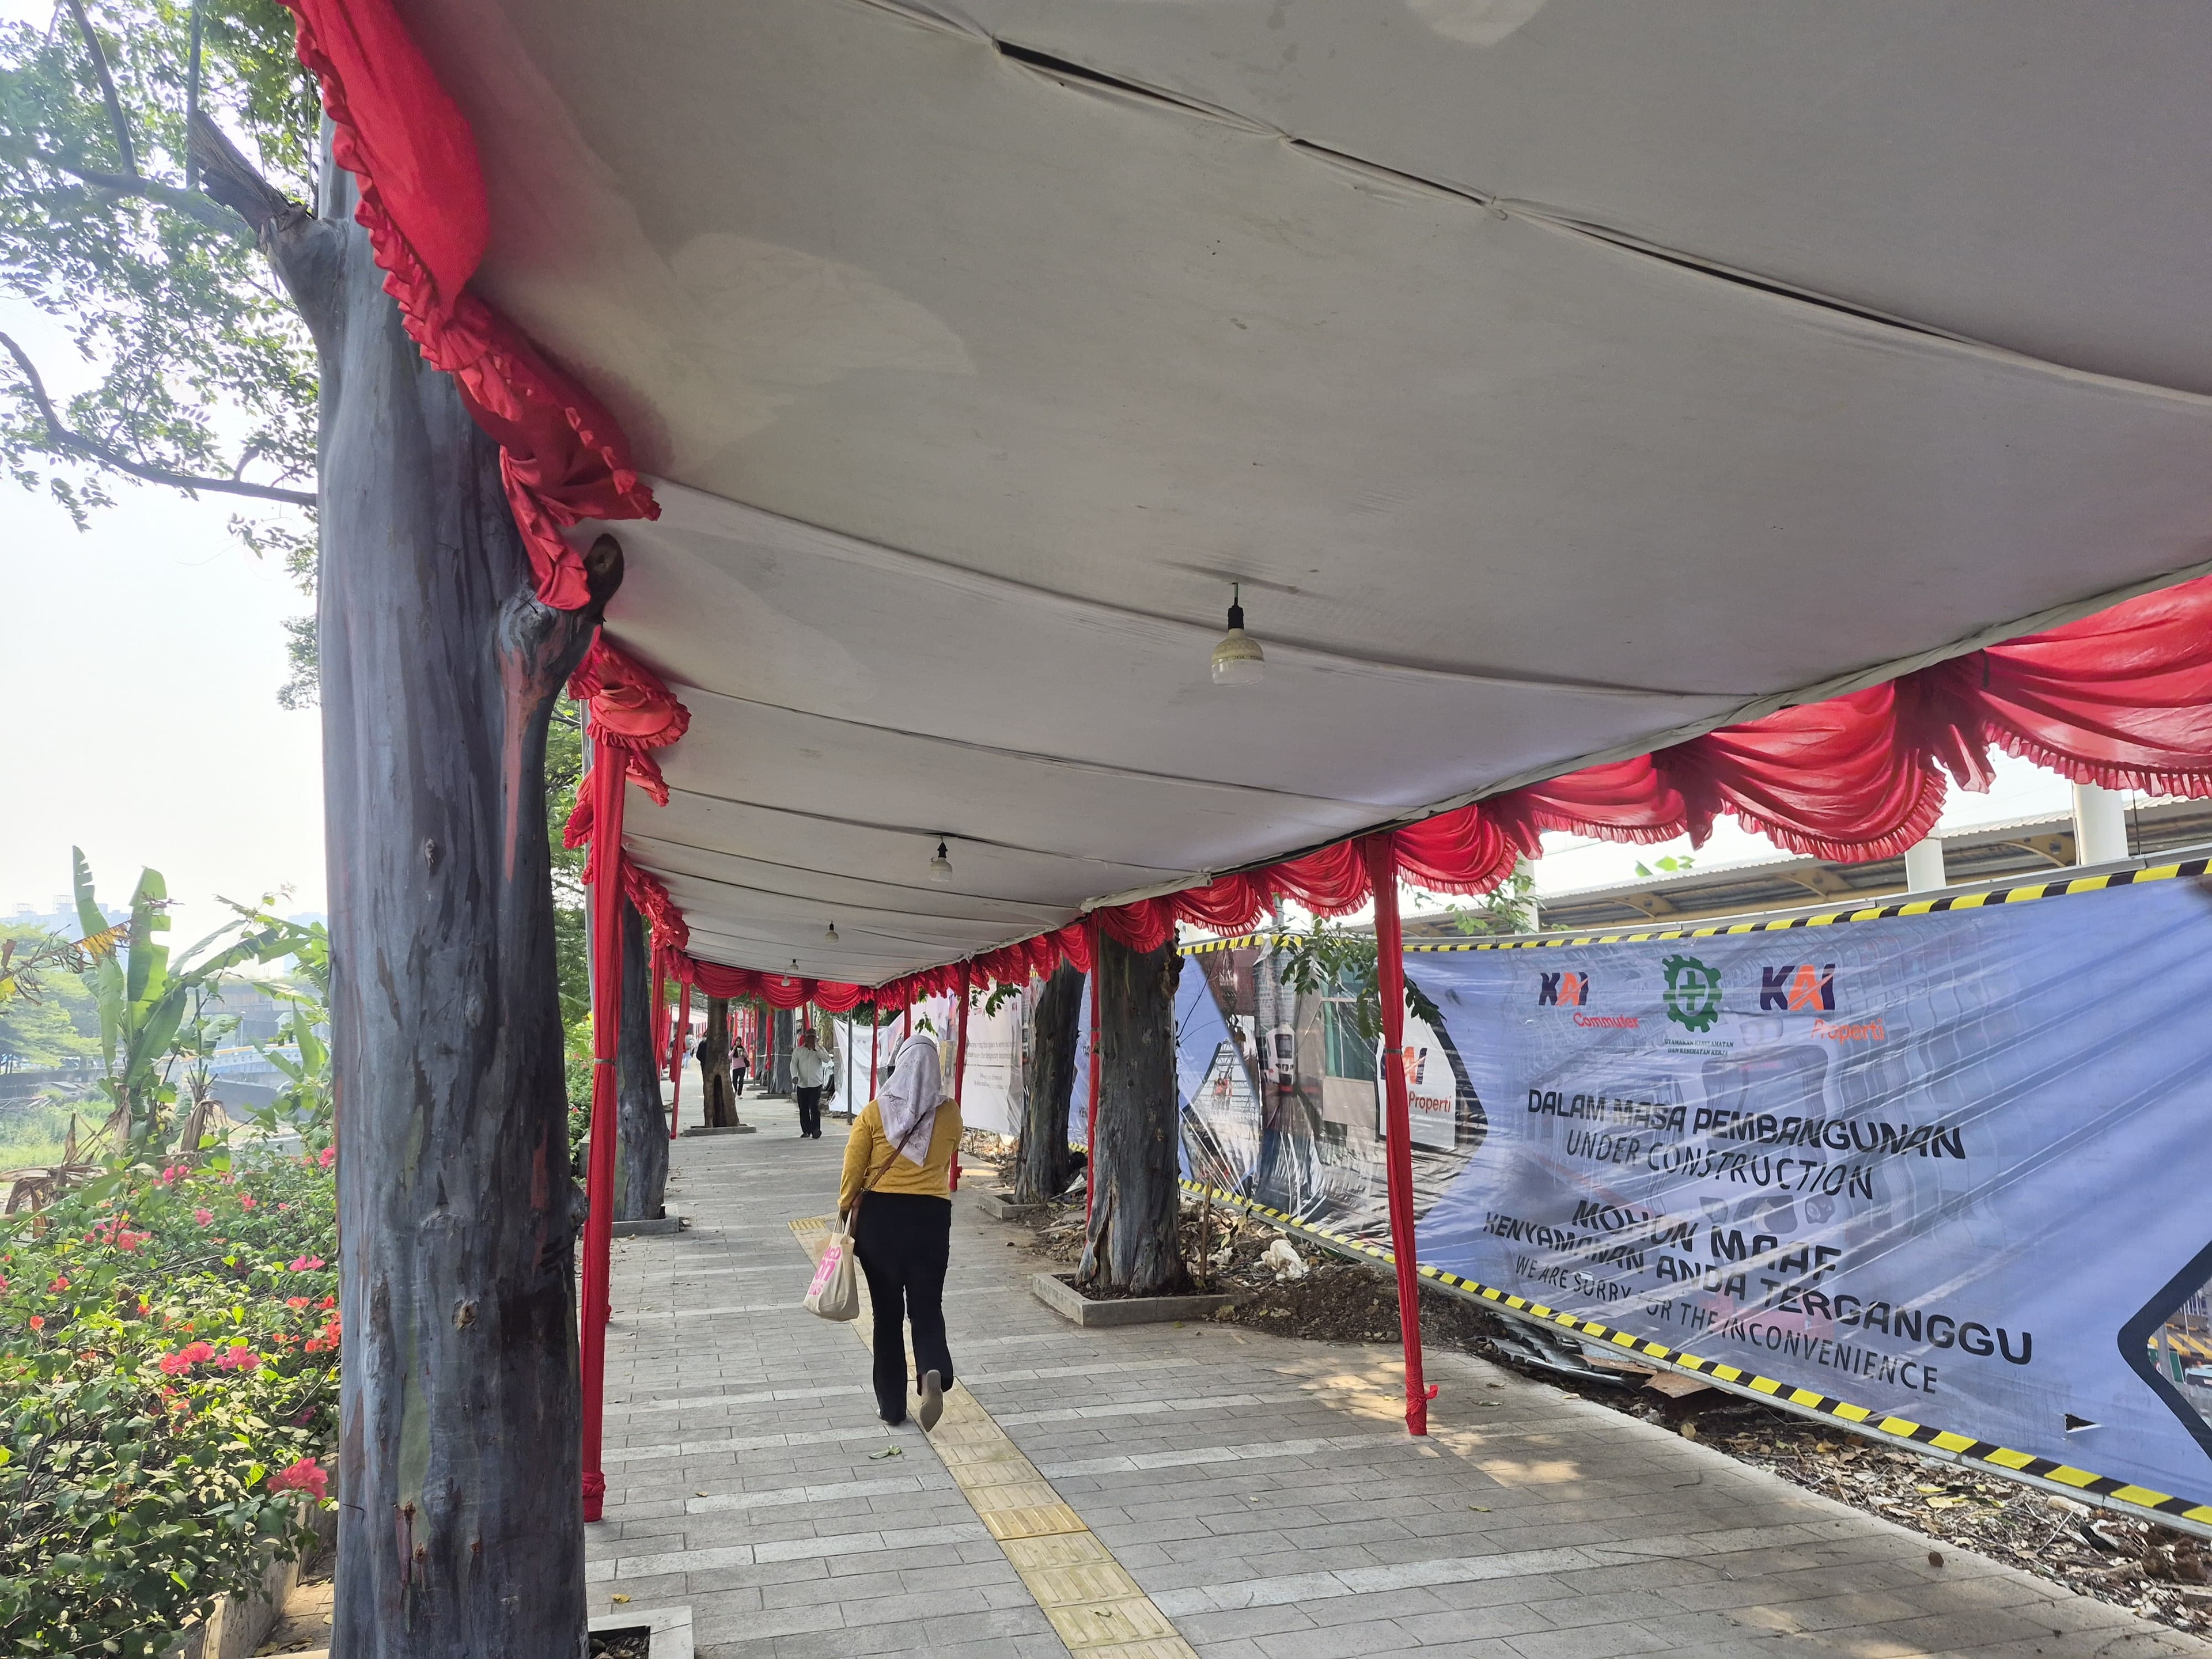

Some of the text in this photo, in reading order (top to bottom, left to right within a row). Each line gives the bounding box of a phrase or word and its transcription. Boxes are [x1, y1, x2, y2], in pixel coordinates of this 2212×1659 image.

[1539, 972, 1589, 1006] KAI
[1760, 964, 1836, 1011] KAI
[1573, 1012, 1639, 1029] Commuter
[1811, 1017, 1885, 1044] Properti
[1409, 1091, 1451, 1113] Properti
[1528, 1089, 1966, 1159] DALAM MASA PEMBANGUNAN
[1567, 1129, 1873, 1199] UNDER CONSTRUCTION
[1571, 1200, 1699, 1252] MOHON
[1483, 1211, 2032, 1365] KENYAMANAN ANDA TERGANGGU
[1515, 1255, 1538, 1279] WE
[1539, 1266, 1569, 1290] ARE
[1680, 1302, 1719, 1334] THE
[1722, 1317, 1938, 1394] INCONVENIENCE
